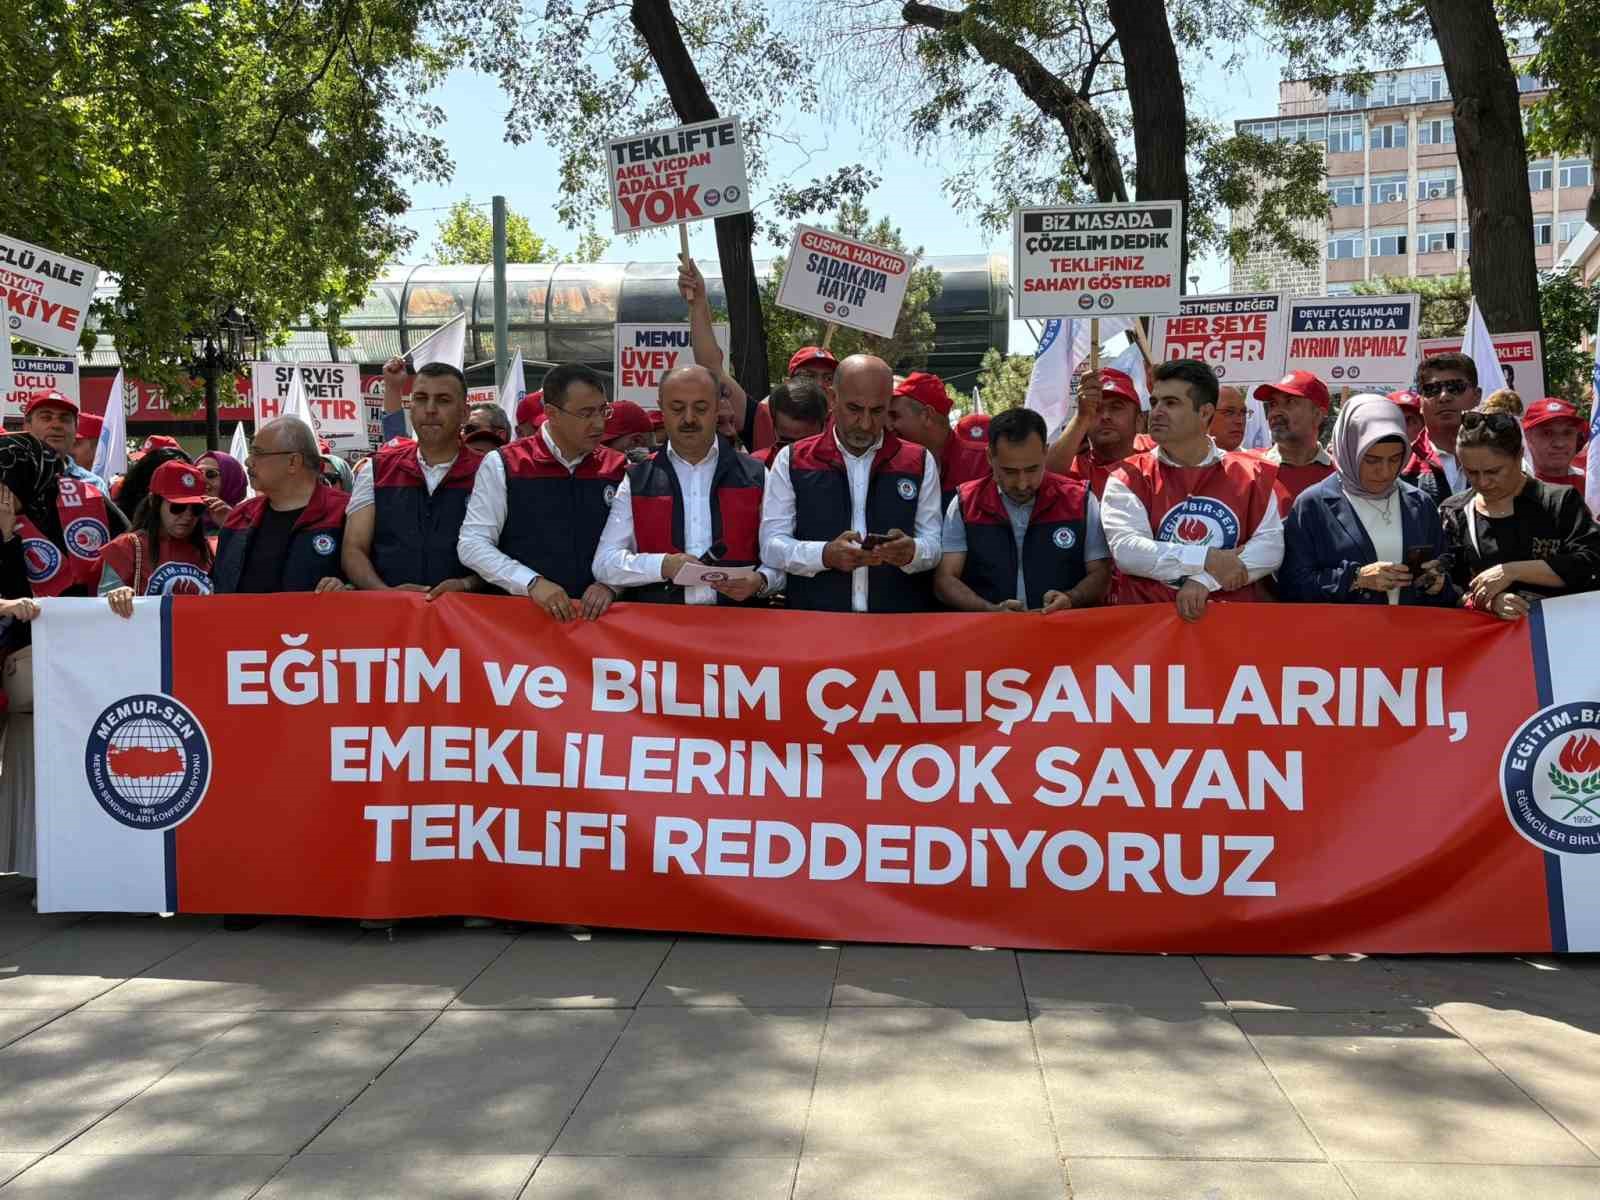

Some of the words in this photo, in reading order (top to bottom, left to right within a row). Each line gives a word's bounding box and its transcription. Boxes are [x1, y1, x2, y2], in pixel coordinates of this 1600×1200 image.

[611, 123, 736, 164] TEKLİFTE
[652, 152, 711, 173] VİCDAN
[618, 170, 687, 196] ADALET
[618, 184, 704, 227] YOK
[1042, 215, 1070, 231] BİZ
[1075, 212, 1154, 229] MASADA
[804, 234, 850, 259] SUSMA
[852, 247, 903, 273] HAYKIR
[1026, 233, 1107, 255] ÇÖZELİM
[1111, 233, 1169, 250] DEDİK
[35, 259, 84, 287] AİLE
[806, 253, 888, 293] SADAKAYA
[1049, 256, 1144, 273] TEKLİFİNİZ
[0, 270, 43, 294] ÜYÜK
[817, 277, 866, 307] HAYIR
[1024, 276, 1085, 292] SAHAYI
[1087, 273, 1171, 290] GÖSTERDİ
[1235, 298, 1275, 312] DEĞER
[1300, 309, 1337, 318] DEVLET
[1166, 318, 1208, 335] HER
[1211, 314, 1267, 336] ŞEYE
[636, 331, 692, 347] MEMU
[1165, 336, 1262, 362] DEĞER
[1290, 337, 1340, 358] AYRIM
[1343, 336, 1408, 357] YAPMAZ
[28, 361, 66, 372] MEMUR
[621, 347, 679, 369] ÜVEY
[278, 383, 343, 398] HMETİ
[261, 398, 356, 420] HTIR
[226, 633, 461, 707] EĞİTİM
[482, 661, 567, 709] ve
[590, 657, 781, 721] BİLİM
[97, 701, 195, 740] MEMUR-SEN
[330, 726, 823, 799] EMEKLİLERİNİ
[848, 744, 1011, 806] YOK
[1034, 747, 1304, 811] SAYAN
[93, 754, 105, 790] MEMUR
[152, 753, 201, 822] KONFEDERASYONU
[1516, 789, 1566, 843] EĞİTİMCİLER
[1573, 815, 1593, 824] 1992
[364, 805, 628, 871] TEKLİFİ
[653, 816, 1277, 897] REDDEDİYORUZ
